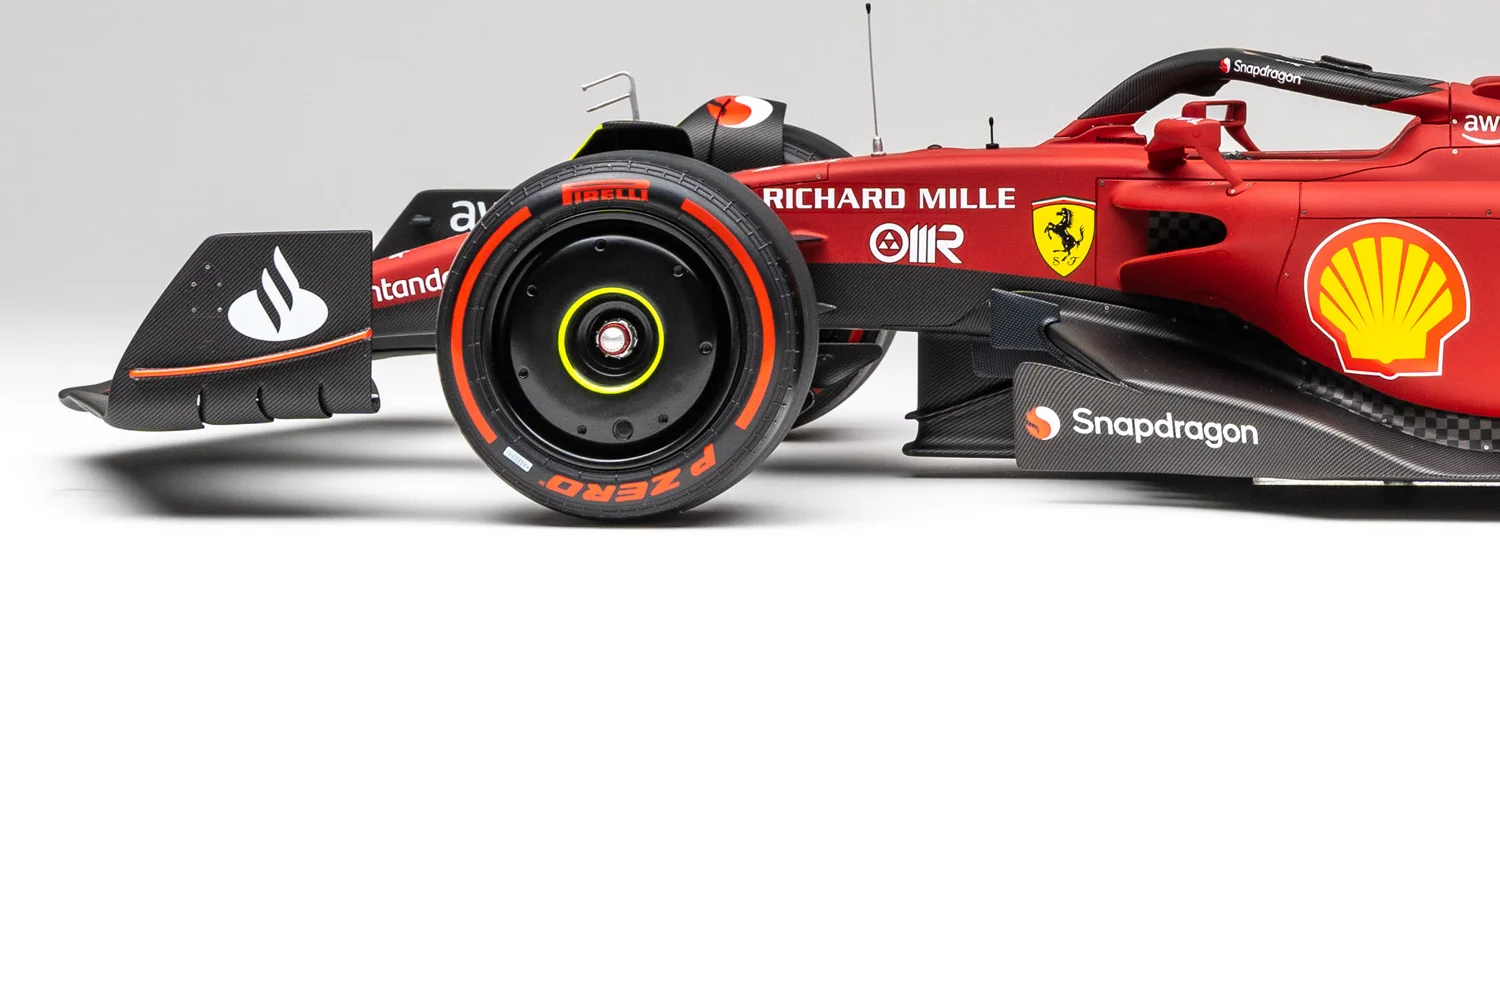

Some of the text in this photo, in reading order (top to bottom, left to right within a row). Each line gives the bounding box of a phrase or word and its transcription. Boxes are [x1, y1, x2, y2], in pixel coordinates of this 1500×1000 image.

[1234, 59, 1302, 85] Snapdragon
[561, 179, 650, 206] PIRELLI
[762, 187, 1016, 209] RICHARD MILLE
[1072, 407, 1259, 449] Snapdragon
[545, 443, 717, 503] P ZERO
